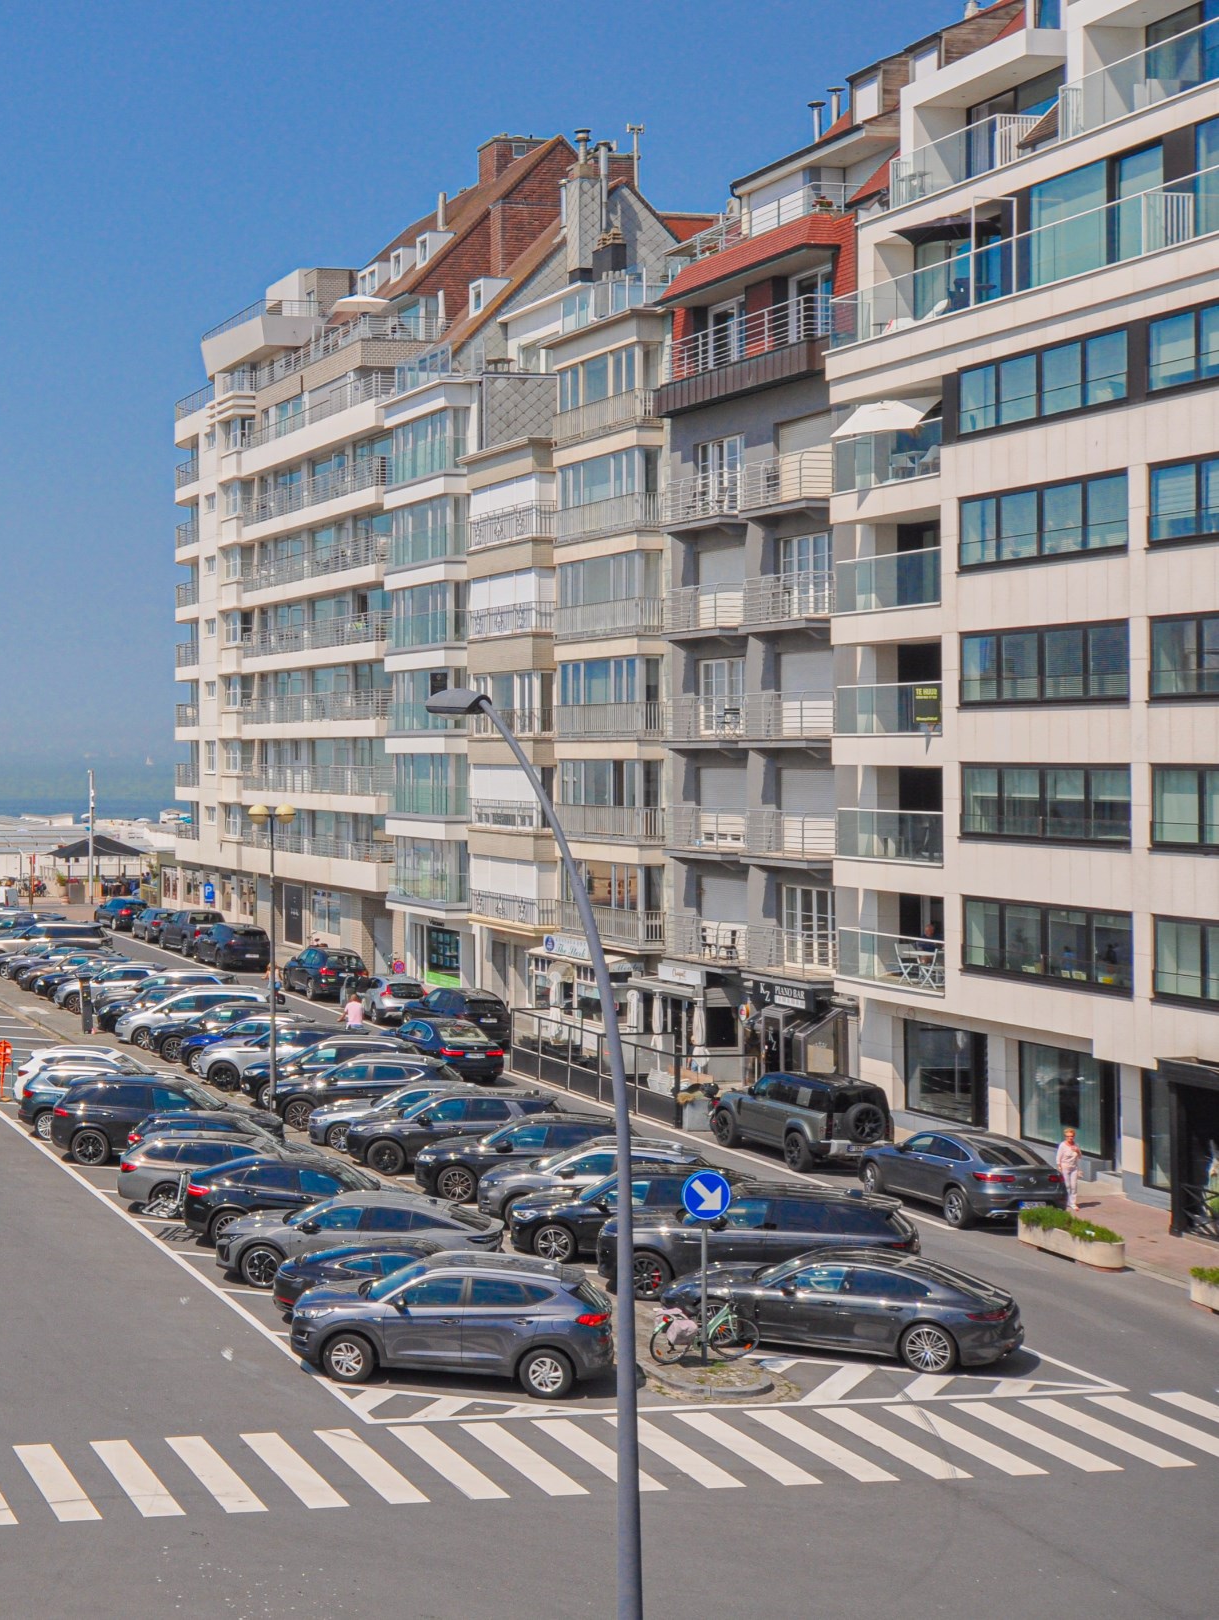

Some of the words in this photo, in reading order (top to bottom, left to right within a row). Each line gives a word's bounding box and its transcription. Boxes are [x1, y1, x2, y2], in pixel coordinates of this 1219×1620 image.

[205, 886, 213, 897] P
[774, 985, 792, 997] PIANO
[793, 989, 806, 1000] BAR
